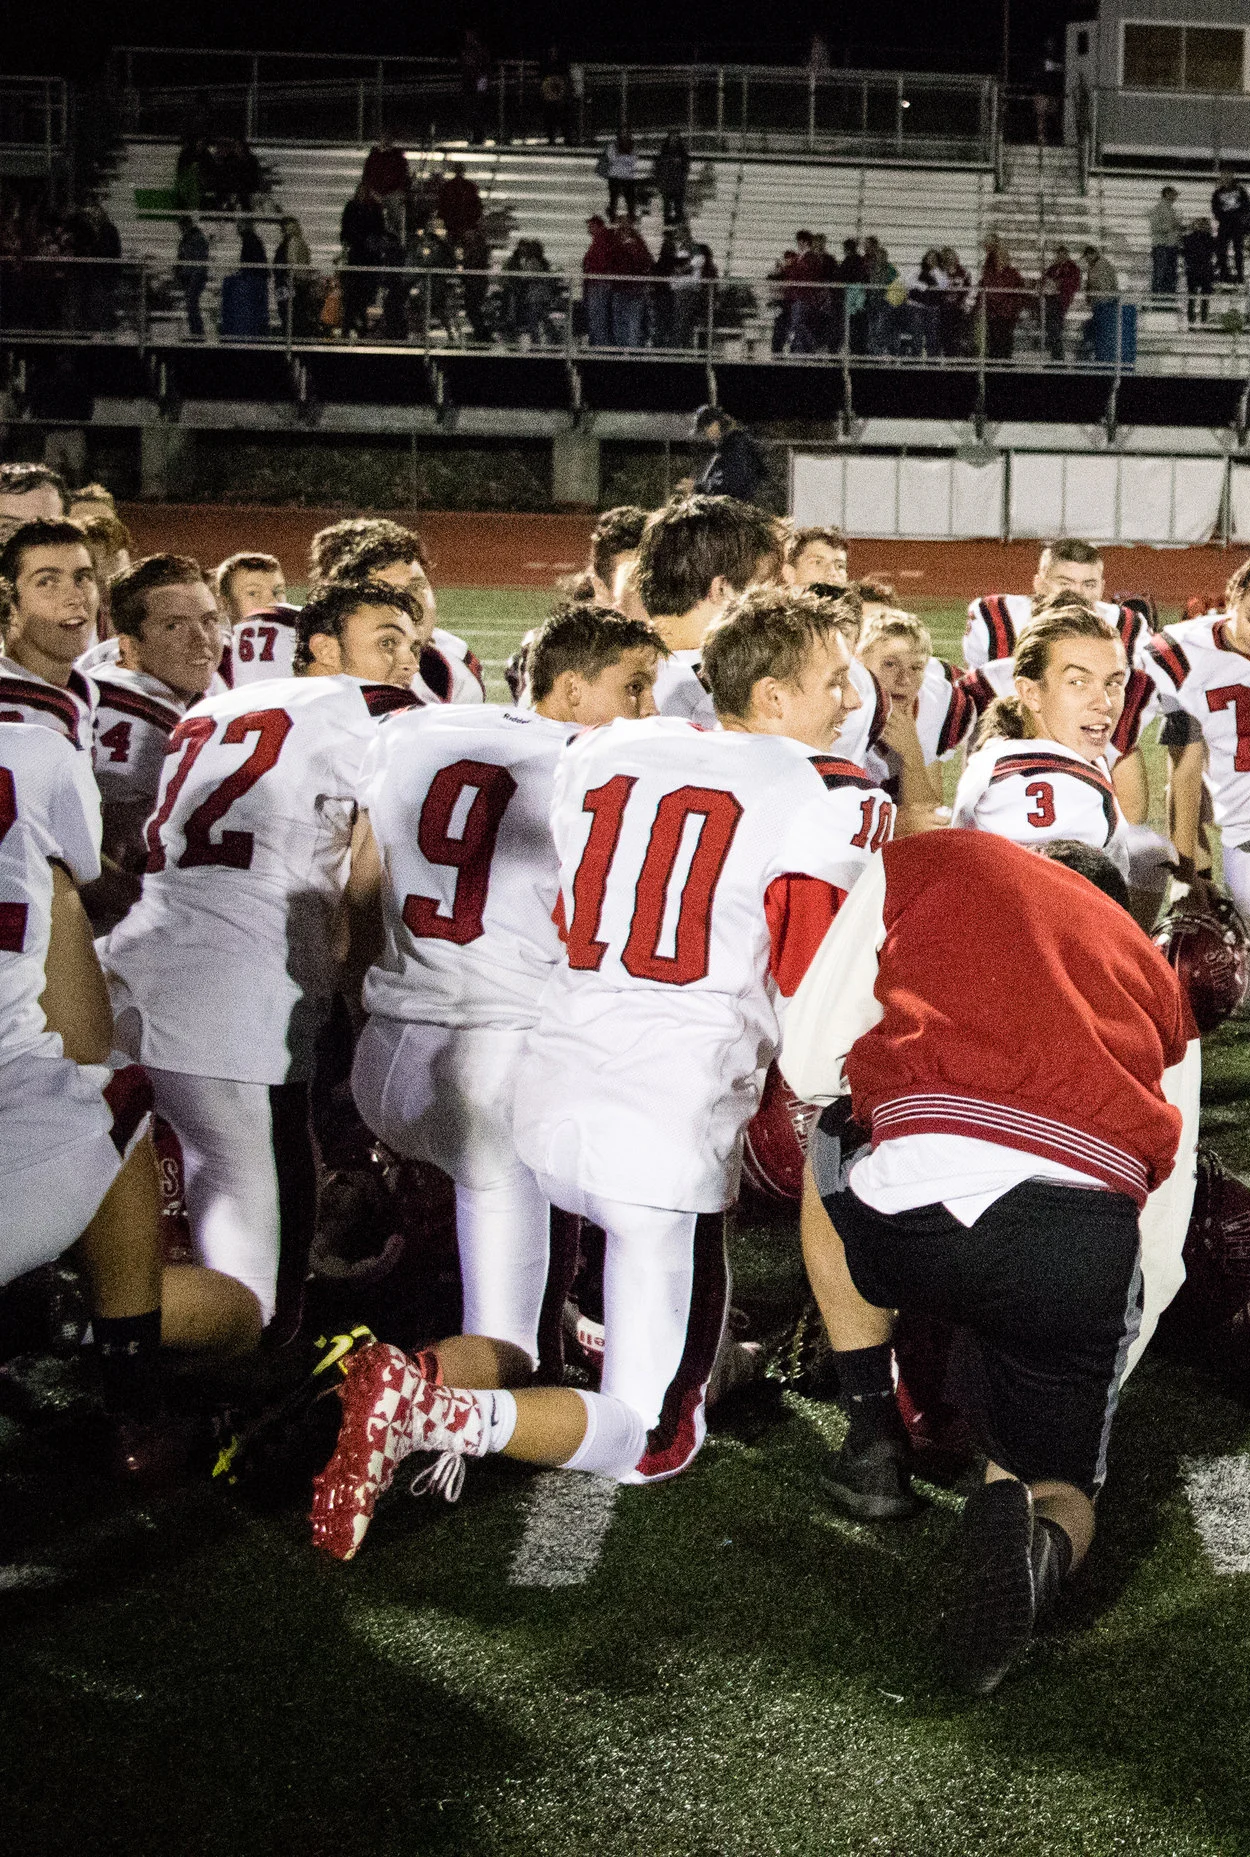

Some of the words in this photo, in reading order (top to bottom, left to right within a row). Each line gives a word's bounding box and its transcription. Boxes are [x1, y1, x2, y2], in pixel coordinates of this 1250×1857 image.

[239, 626, 279, 662] 67
[92, 720, 132, 766] 4
[145, 708, 294, 874] 72
[1025, 783, 1055, 828] 3
[402, 759, 518, 945] 9
[850, 795, 892, 854] 10
[567, 774, 745, 986] 10
